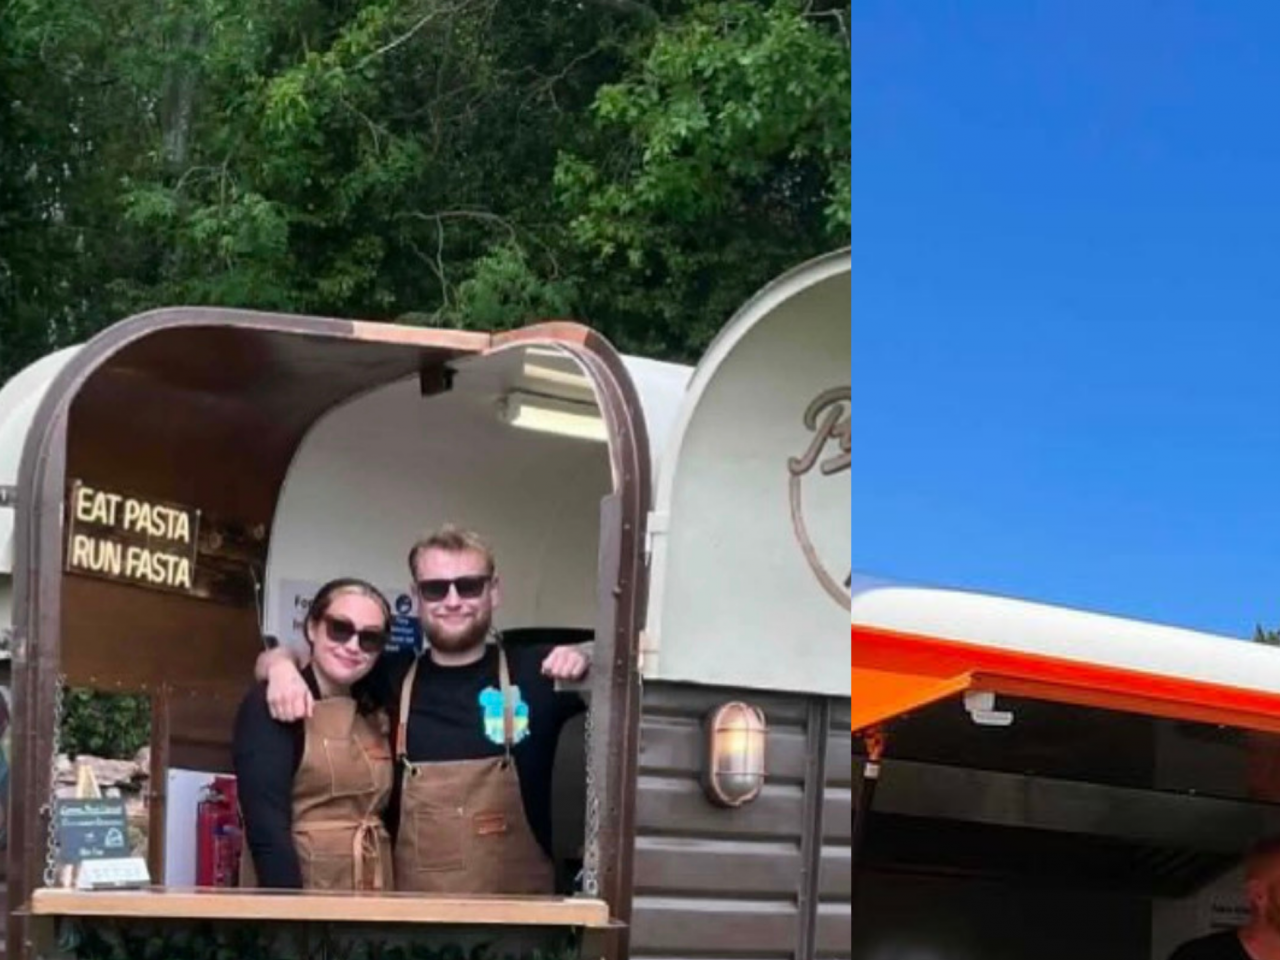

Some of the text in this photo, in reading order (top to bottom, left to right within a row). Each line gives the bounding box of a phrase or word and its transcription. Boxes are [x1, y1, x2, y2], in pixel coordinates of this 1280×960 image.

[76, 487, 190, 544] EAT PASTA
[72, 534, 192, 589] RUN FASTA
